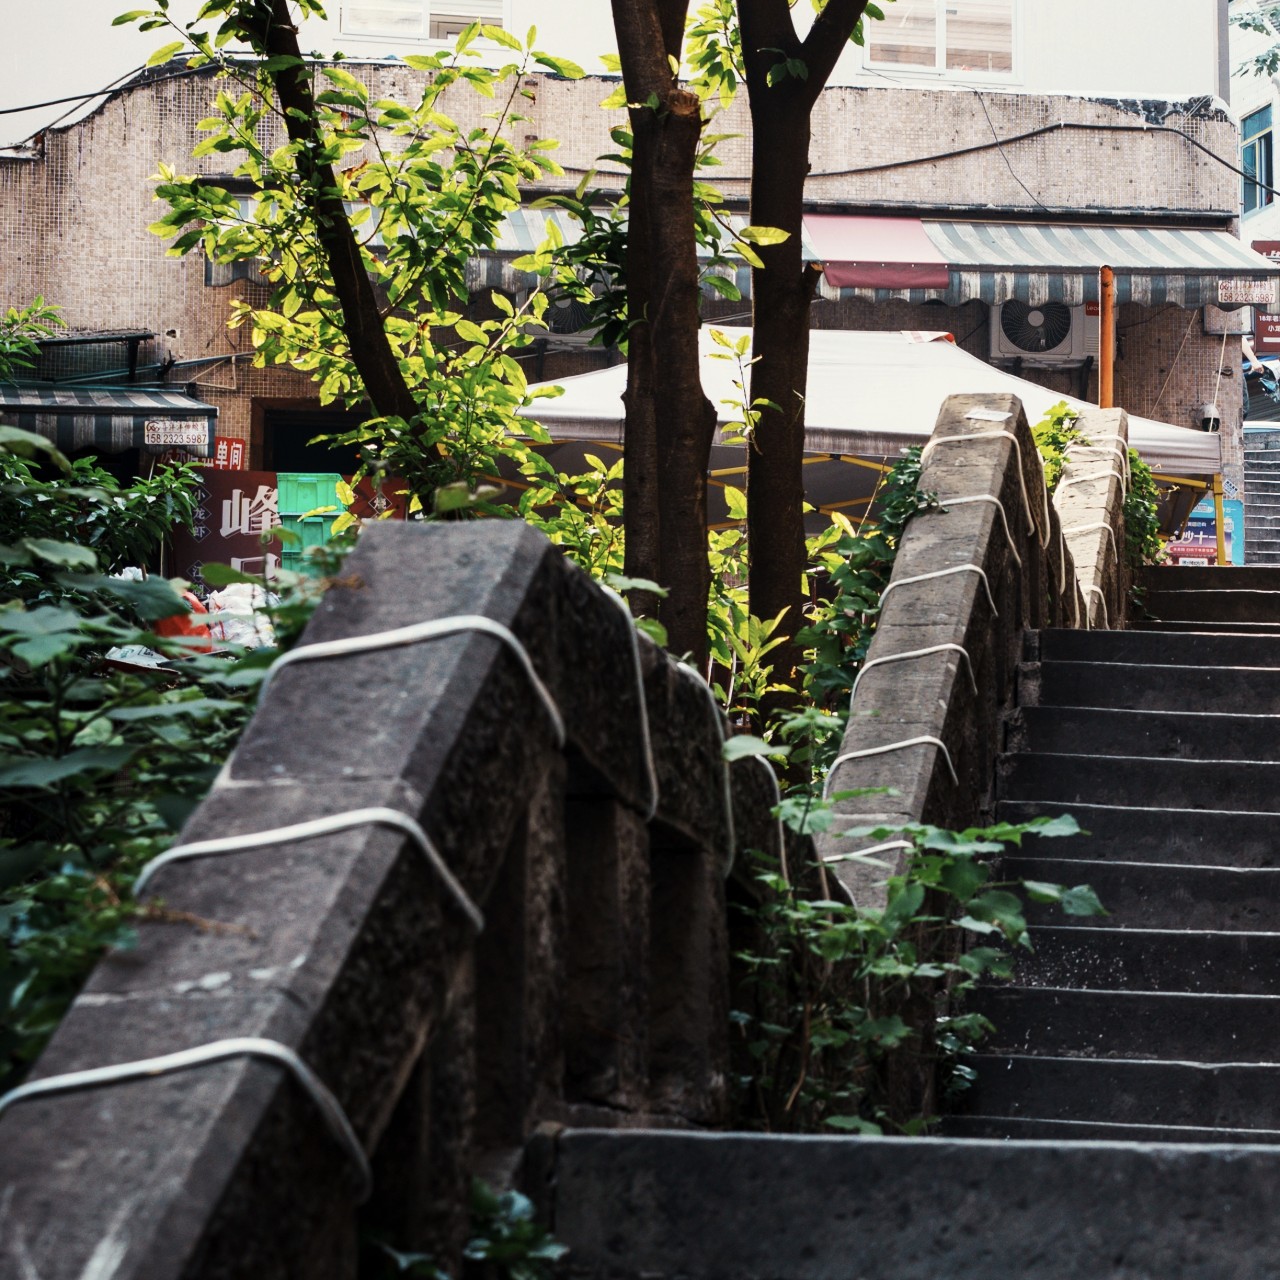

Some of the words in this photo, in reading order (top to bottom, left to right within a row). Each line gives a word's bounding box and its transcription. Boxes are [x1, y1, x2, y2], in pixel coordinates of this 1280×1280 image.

[1220, 293, 1233, 302] 158
[1235, 293, 1254, 302] 2323
[1256, 293, 1274, 303] 5987
[146, 433, 160, 443] 158
[163, 433, 184, 444] 2323
[186, 434, 207, 444] 5987
